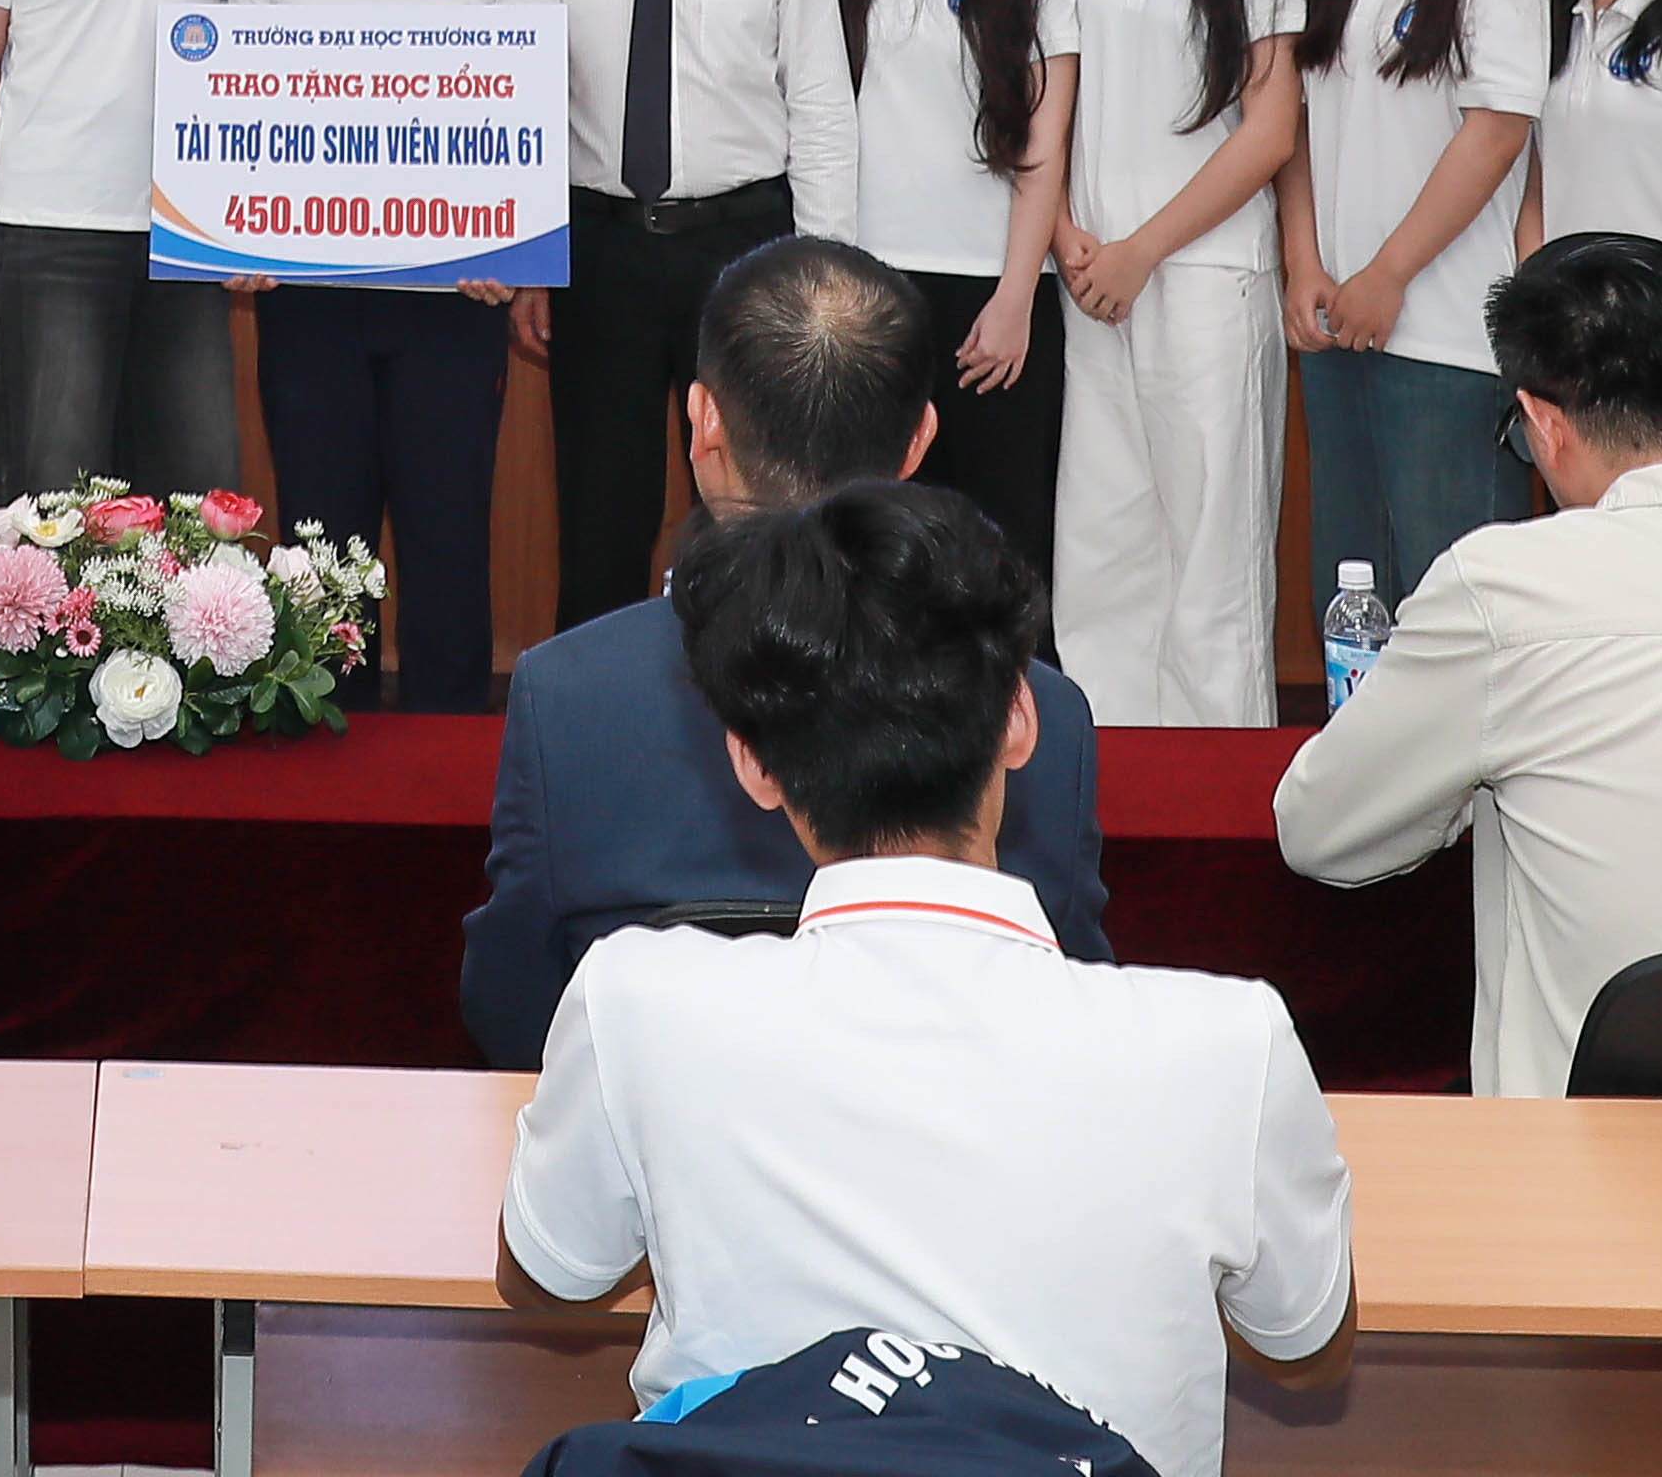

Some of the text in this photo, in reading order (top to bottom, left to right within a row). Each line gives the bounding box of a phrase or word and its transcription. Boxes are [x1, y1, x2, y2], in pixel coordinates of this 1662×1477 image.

[232, 25, 314, 46] TRƯỜNG
[319, 30, 355, 50] ĐẠI
[360, 30, 403, 50] HỌC
[407, 26, 492, 46] THƯƠNG
[497, 30, 536, 50] MẠI
[208, 62, 515, 105] TRAO TẶNG HỌC BỔNG
[175, 114, 543, 172] TÀI TRỢ CHO SINH VIÊN KHÓA 61
[224, 195, 517, 239] 450.000.000vnđ
